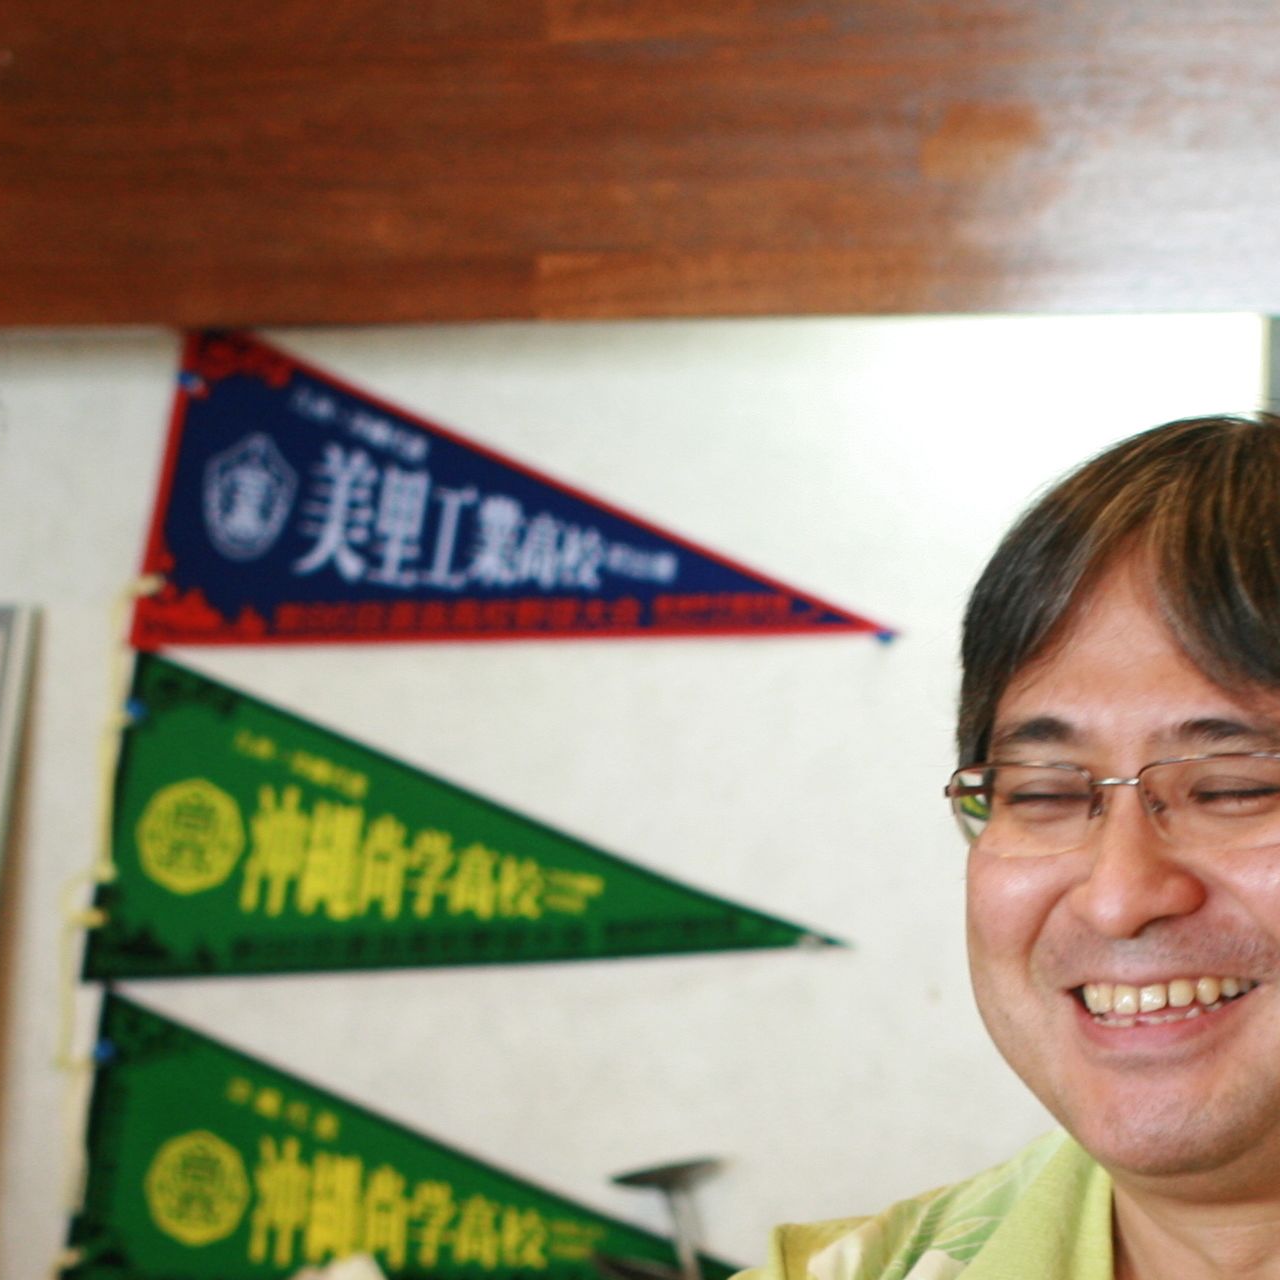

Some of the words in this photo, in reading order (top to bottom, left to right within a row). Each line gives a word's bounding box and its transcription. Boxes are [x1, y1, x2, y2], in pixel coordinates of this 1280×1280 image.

[292, 446, 601, 588] 美里工業高校
